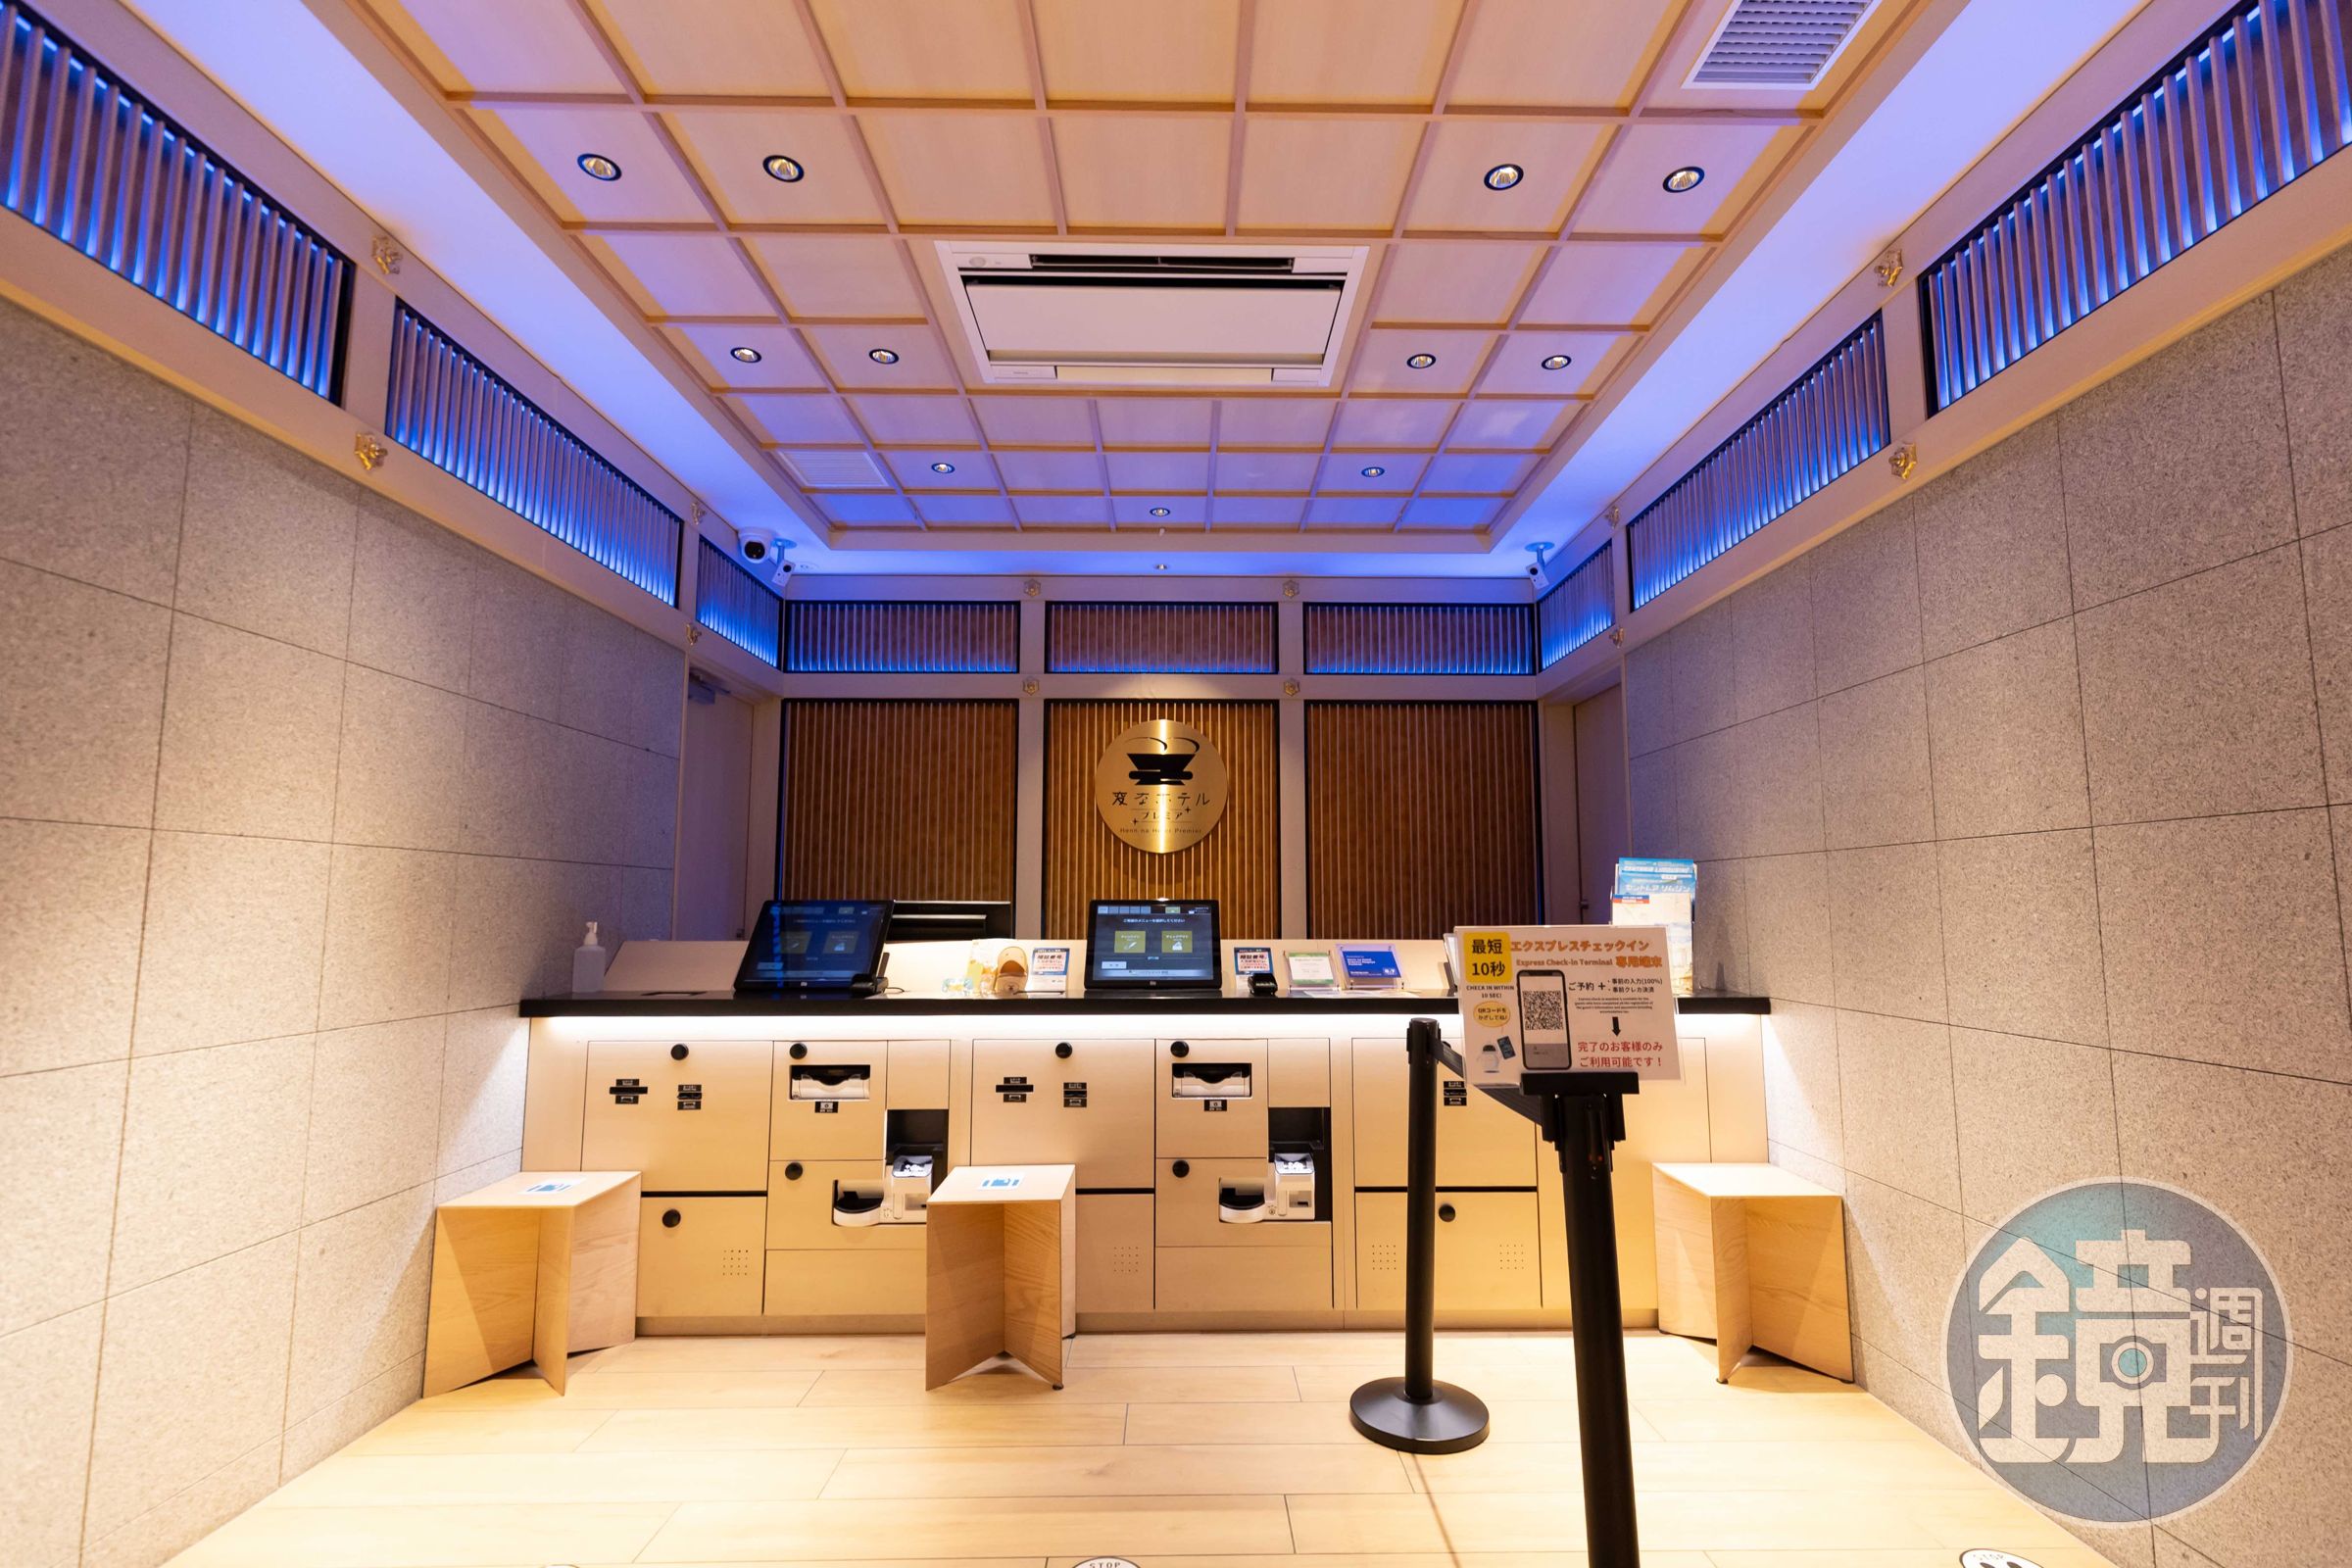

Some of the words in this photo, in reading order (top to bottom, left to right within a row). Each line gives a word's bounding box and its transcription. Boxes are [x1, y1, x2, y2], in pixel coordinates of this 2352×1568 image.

[1111, 791, 1210, 807] 変なホテル
[1472, 938, 1503, 955] 最短
[1510, 940, 1649, 953] エクスプレスチェックイン
[1516, 958, 1545, 967] Express
[1615, 956, 1663, 968] 専用端末
[1472, 960, 1506, 977] 10秒
[1568, 982, 1594, 992] ご予約
[1577, 1041, 1663, 1053] 完了のお客様のみ
[1580, 1056, 1662, 1067] ご利用可能です！
